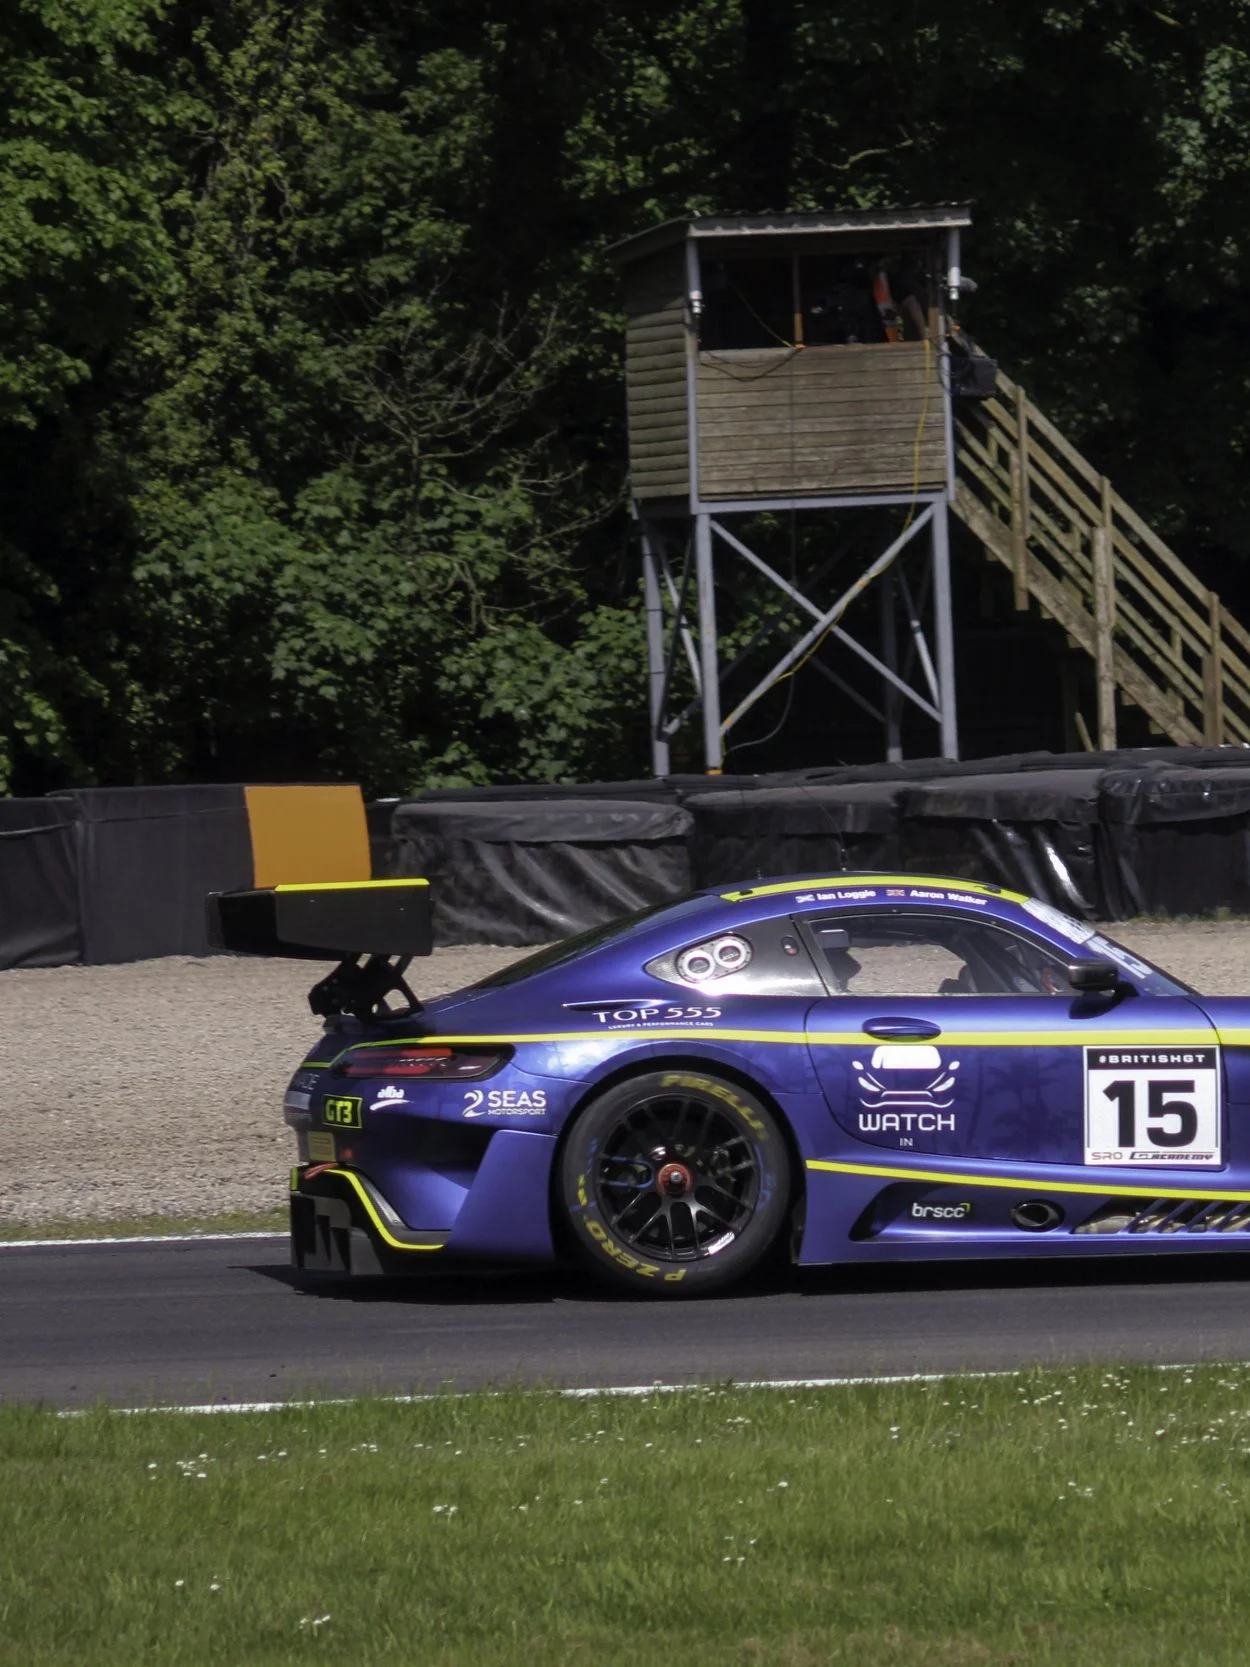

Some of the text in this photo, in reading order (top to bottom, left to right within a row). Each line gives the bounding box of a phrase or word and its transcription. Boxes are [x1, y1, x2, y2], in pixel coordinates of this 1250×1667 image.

[817, 889, 876, 900] Ian Loggie
[910, 890, 988, 905] Aaron Walker
[592, 1007, 722, 1022] TOP 555
[1099, 1054, 1206, 1063] #BRITISHGT
[488, 1090, 547, 1108] SEAS
[325, 1099, 353, 1124] GT3
[1102, 1080, 1198, 1148] 15
[858, 1113, 956, 1131] WATCH
[899, 1137, 914, 1147] IN
[1091, 1152, 1123, 1160] SRO
[911, 1203, 966, 1218] brscc
[586, 1221, 687, 1281] P ZERO
